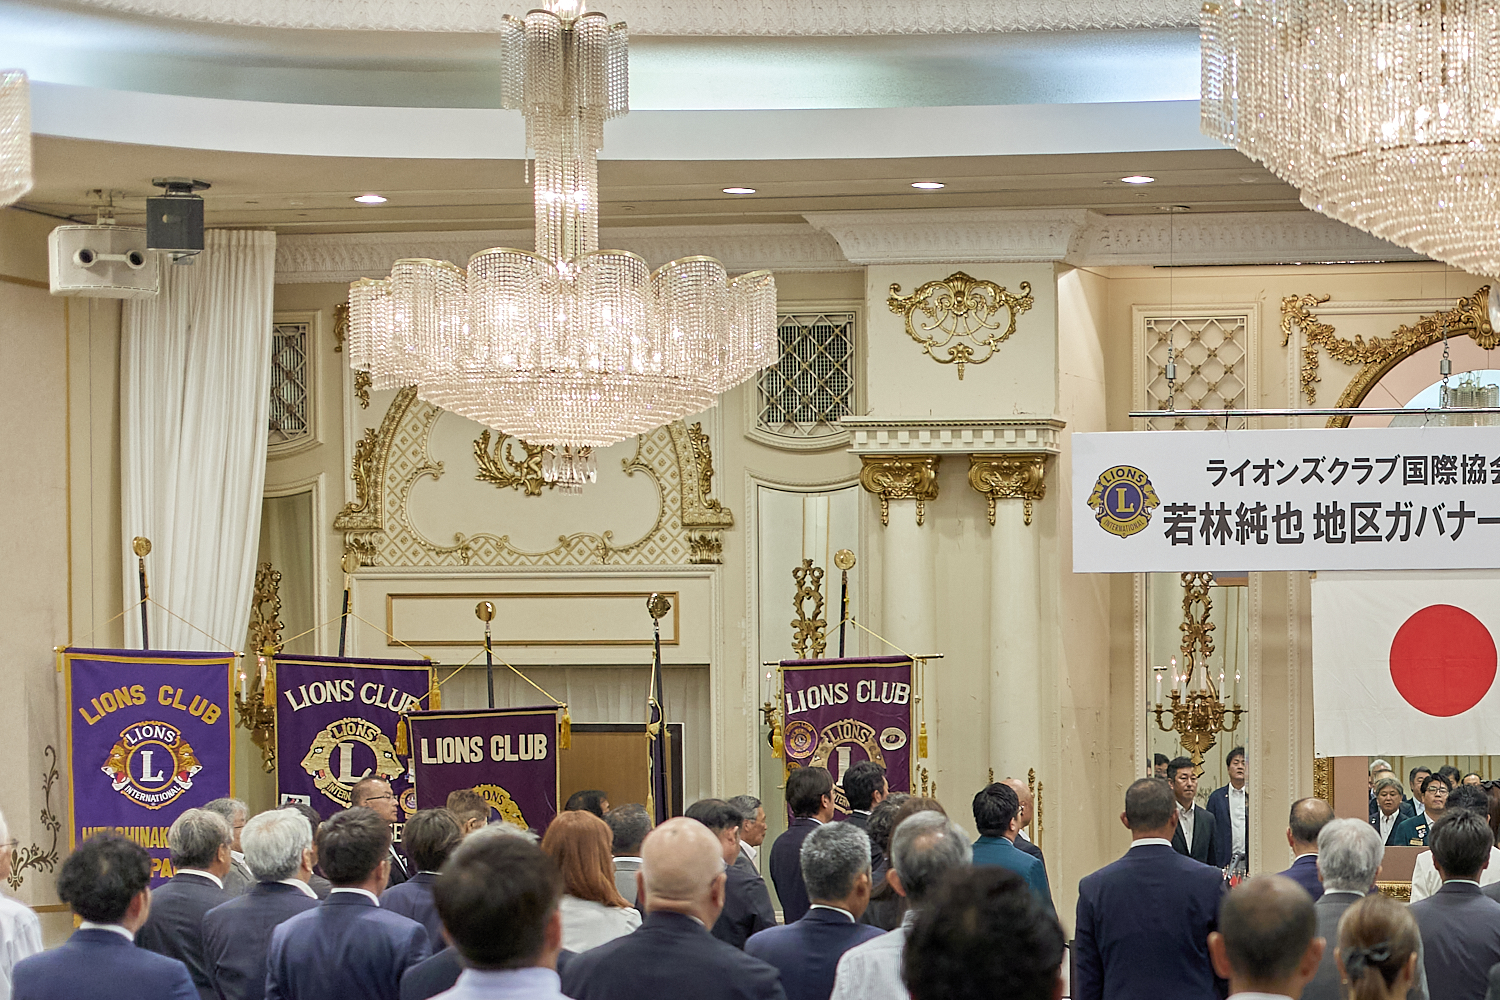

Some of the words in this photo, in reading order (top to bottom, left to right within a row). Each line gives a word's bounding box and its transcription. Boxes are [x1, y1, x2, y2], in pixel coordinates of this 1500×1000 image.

[1103, 468, 1145, 483] LIONS
[1116, 488, 1134, 513] L
[1103, 519, 1145, 533] INTERNATIONAL
[78, 684, 147, 726] LIONS
[157, 684, 222, 725] CLUB
[284, 679, 355, 712] LIONS
[785, 682, 849, 715] LIONS
[856, 680, 911, 705] CLUB
[125, 725, 176, 745] LIONS
[331, 722, 377, 742] LIONS
[826, 723, 871, 743] LIONS
[420, 735, 484, 765] LIONS
[490, 733, 548, 762] CLUB
[139, 750, 164, 782] L
[124, 785, 182, 803] INTERNATIONAL
